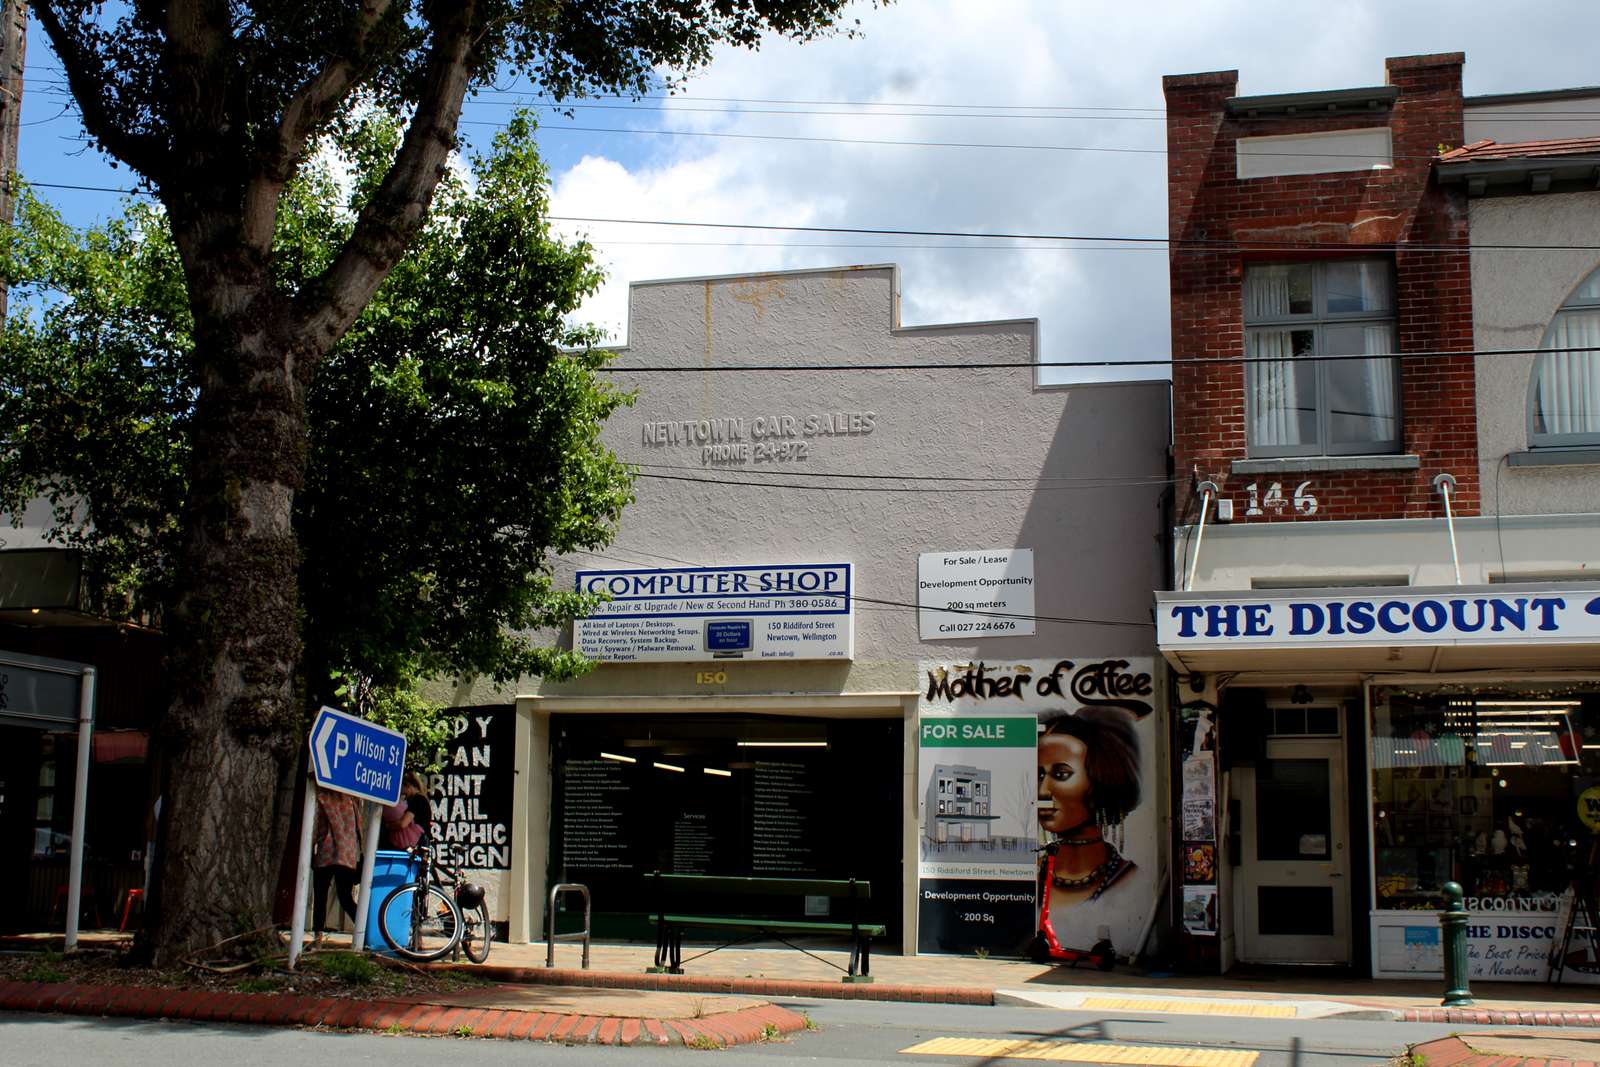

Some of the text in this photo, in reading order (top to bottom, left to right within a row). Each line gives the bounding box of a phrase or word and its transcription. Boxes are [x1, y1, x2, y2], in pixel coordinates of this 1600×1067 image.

[642, 411, 876, 447] NEWTOWN CAR SALES
[701, 443, 748, 465] PHONE
[1246, 481, 1319, 516] 146
[944, 558, 957, 566] For
[959, 556, 976, 565] Sale
[983, 555, 1007, 564] Lease
[588, 571, 838, 595] COMPUTER SHOP
[920, 576, 1033, 589] Development Opportunity
[608, 602, 631, 613] Repair
[645, 601, 678, 612] Upgrade
[686, 599, 705, 610] New
[707, 600, 715, 609] &
[716, 599, 746, 610] Second
[749, 598, 770, 609] Hand
[774, 598, 786, 608] Ph
[947, 600, 1006, 611] 200 sq meters
[1171, 597, 1566, 637] THE DISCOUNT
[616, 621, 639, 629] Laptops
[639, 628, 675, 636] Networking
[768, 621, 835, 630] 150 Riddiford Street
[939, 621, 1016, 632] Call 027 224 6676
[802, 632, 837, 642] Wellington
[605, 645, 630, 653] Spyware
[696, 671, 728, 685] 150
[926, 660, 1153, 713] Mother of Coffee
[923, 724, 1005, 739] FOR SALE
[354, 732, 385, 761] Wilson
[388, 744, 400, 766] St
[355, 761, 392, 791] Carpark
[430, 822, 506, 844] RAPHIC
[924, 890, 1035, 903] Development Opportunity
[964, 912, 995, 924] 200 Sq
[1466, 925, 1491, 938] HE
[1488, 961, 1538, 977] Newtown
